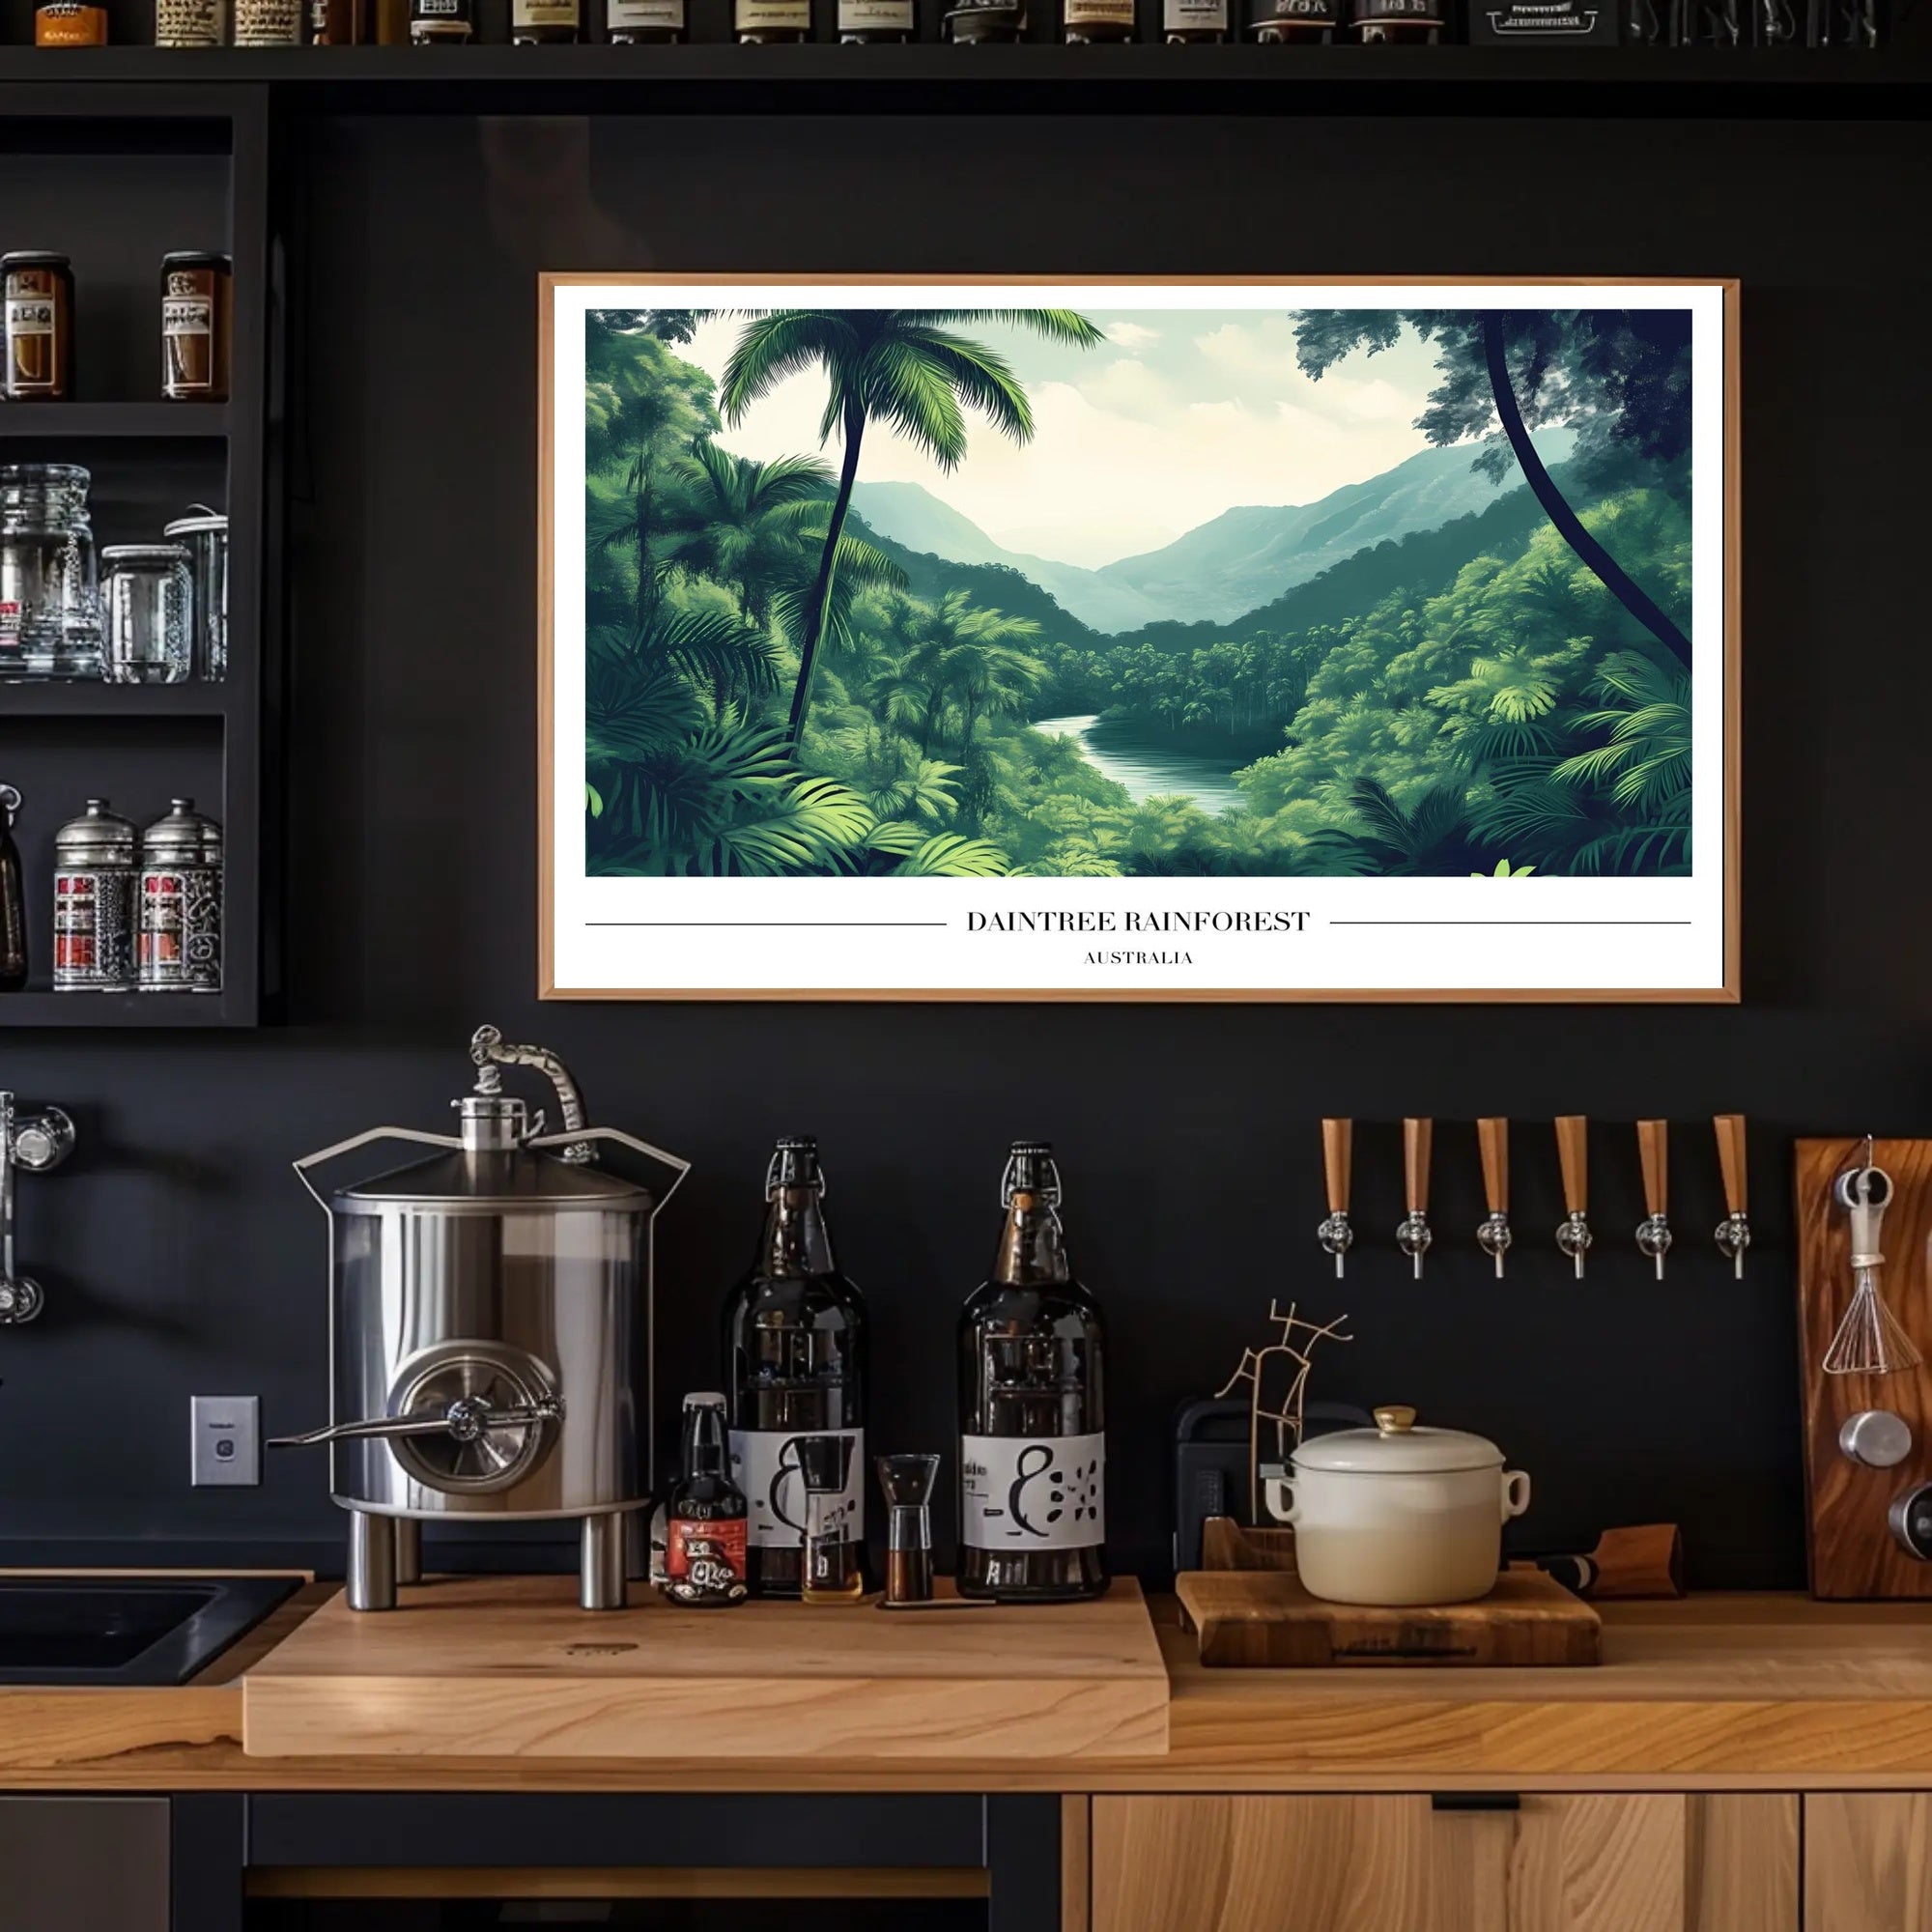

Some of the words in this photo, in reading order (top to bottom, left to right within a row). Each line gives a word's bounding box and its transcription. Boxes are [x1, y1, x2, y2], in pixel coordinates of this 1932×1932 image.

[966, 911, 1117, 931] DAINTREE
[1123, 911, 1311, 931] RAINFOREST
[1084, 951, 1194, 965] AUSTRALIA
